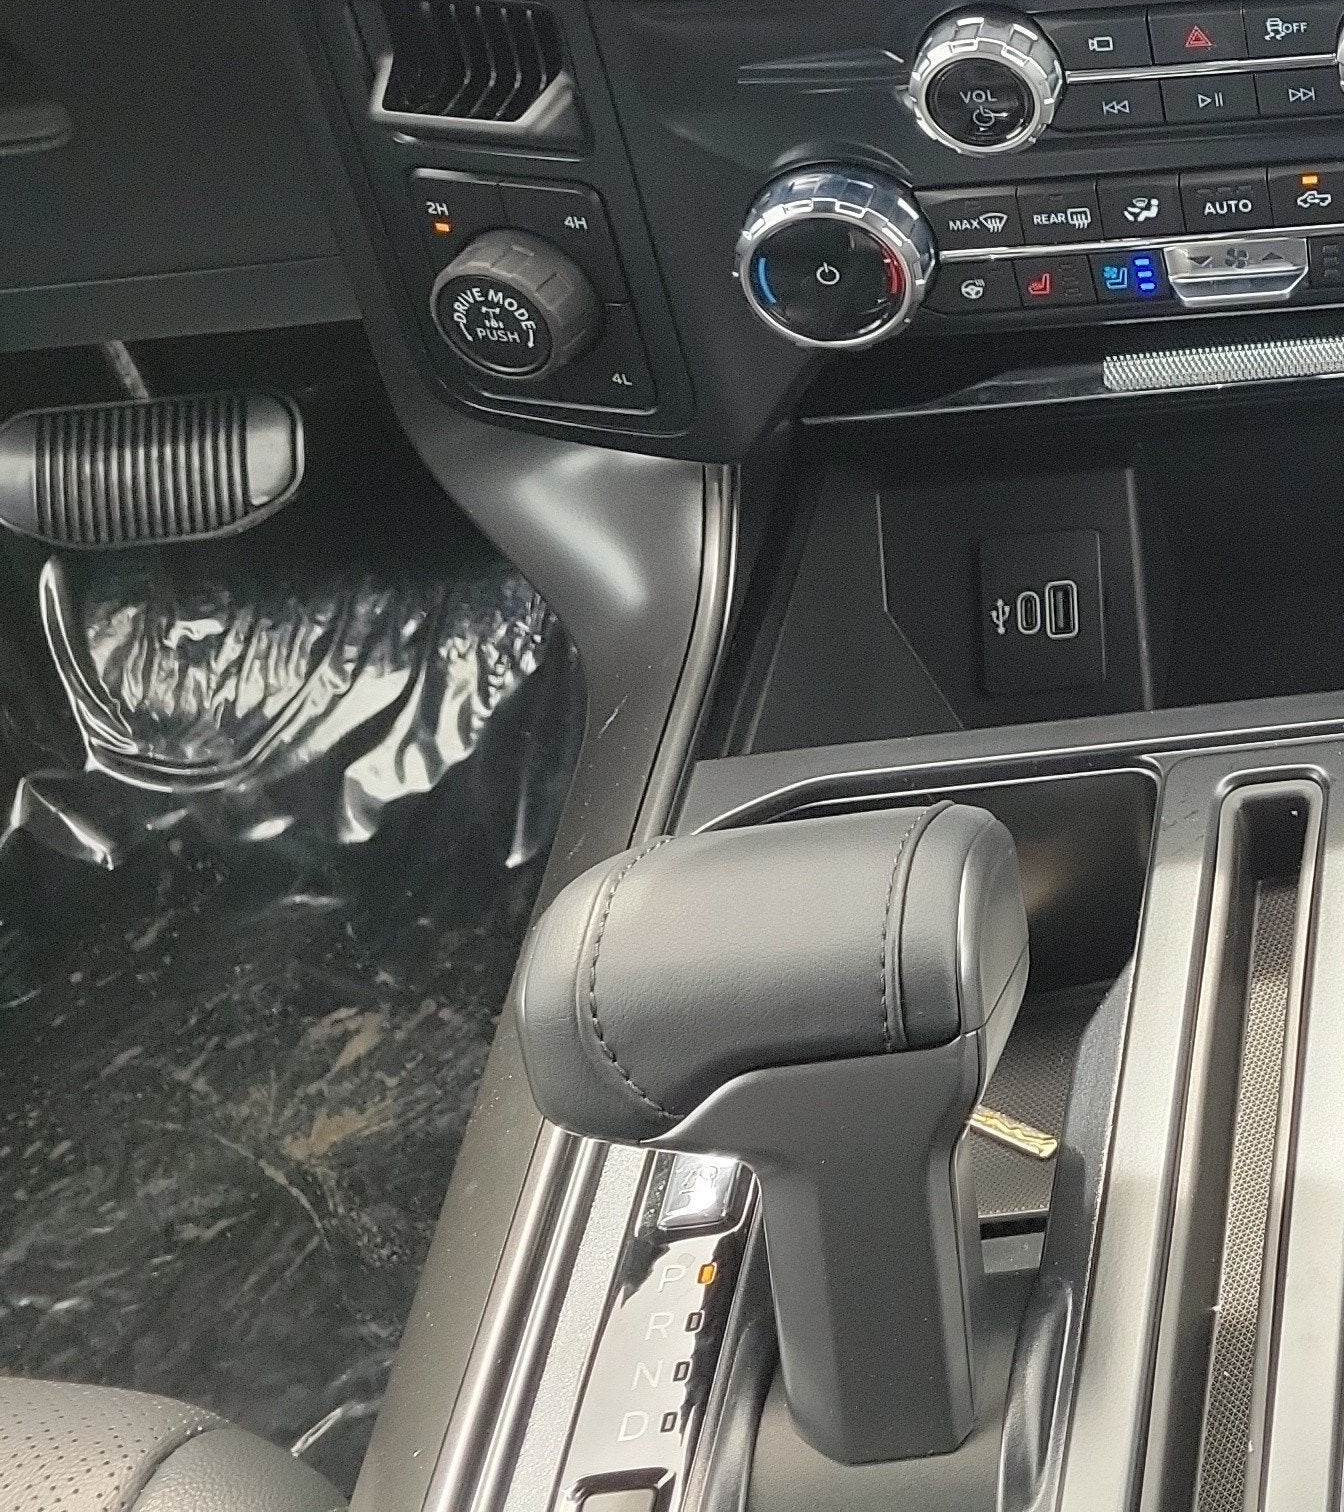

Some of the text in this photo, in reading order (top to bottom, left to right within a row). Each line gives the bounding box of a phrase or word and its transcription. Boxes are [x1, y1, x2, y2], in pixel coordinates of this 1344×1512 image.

[1282, 20, 1308, 34] OFF
[960, 90, 998, 104] VOL
[426, 201, 450, 216] 2H
[1203, 199, 1252, 216] AUTO
[564, 216, 588, 230] 4H
[948, 219, 981, 232] MAX
[1033, 213, 1067, 226] REAR
[453, 287, 536, 330] DRIVE MODE
[476, 326, 521, 344] PUSH
[611, 373, 633, 386] 4L
[656, 1263, 687, 1293] P
[644, 1311, 676, 1342] R
[630, 1361, 664, 1392] N
[617, 1410, 648, 1443] D
